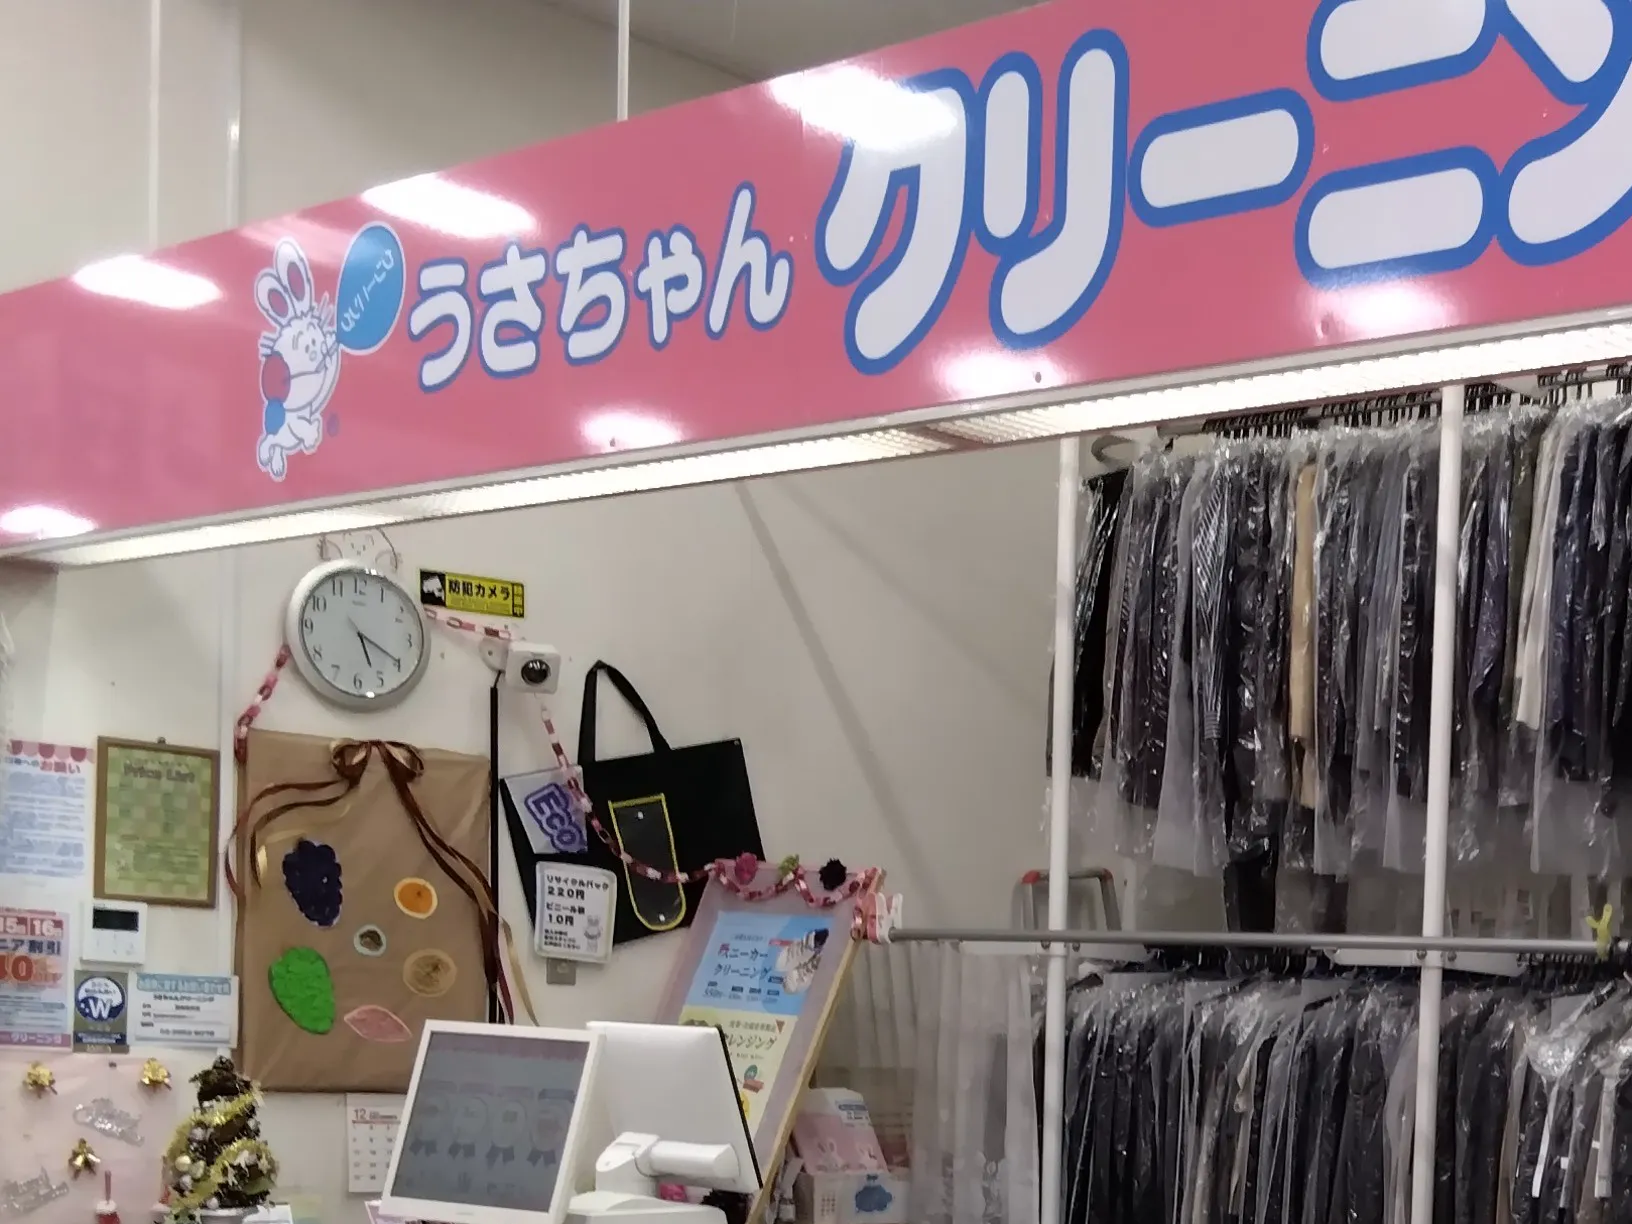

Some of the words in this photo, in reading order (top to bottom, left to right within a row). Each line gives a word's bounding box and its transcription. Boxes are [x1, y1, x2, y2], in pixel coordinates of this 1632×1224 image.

[408, 181, 794, 394] うさちゃん
[448, 578, 511, 601] 防犯カメラ
[547, 886, 586, 901] 220円
[547, 913, 575, 926] 10円
